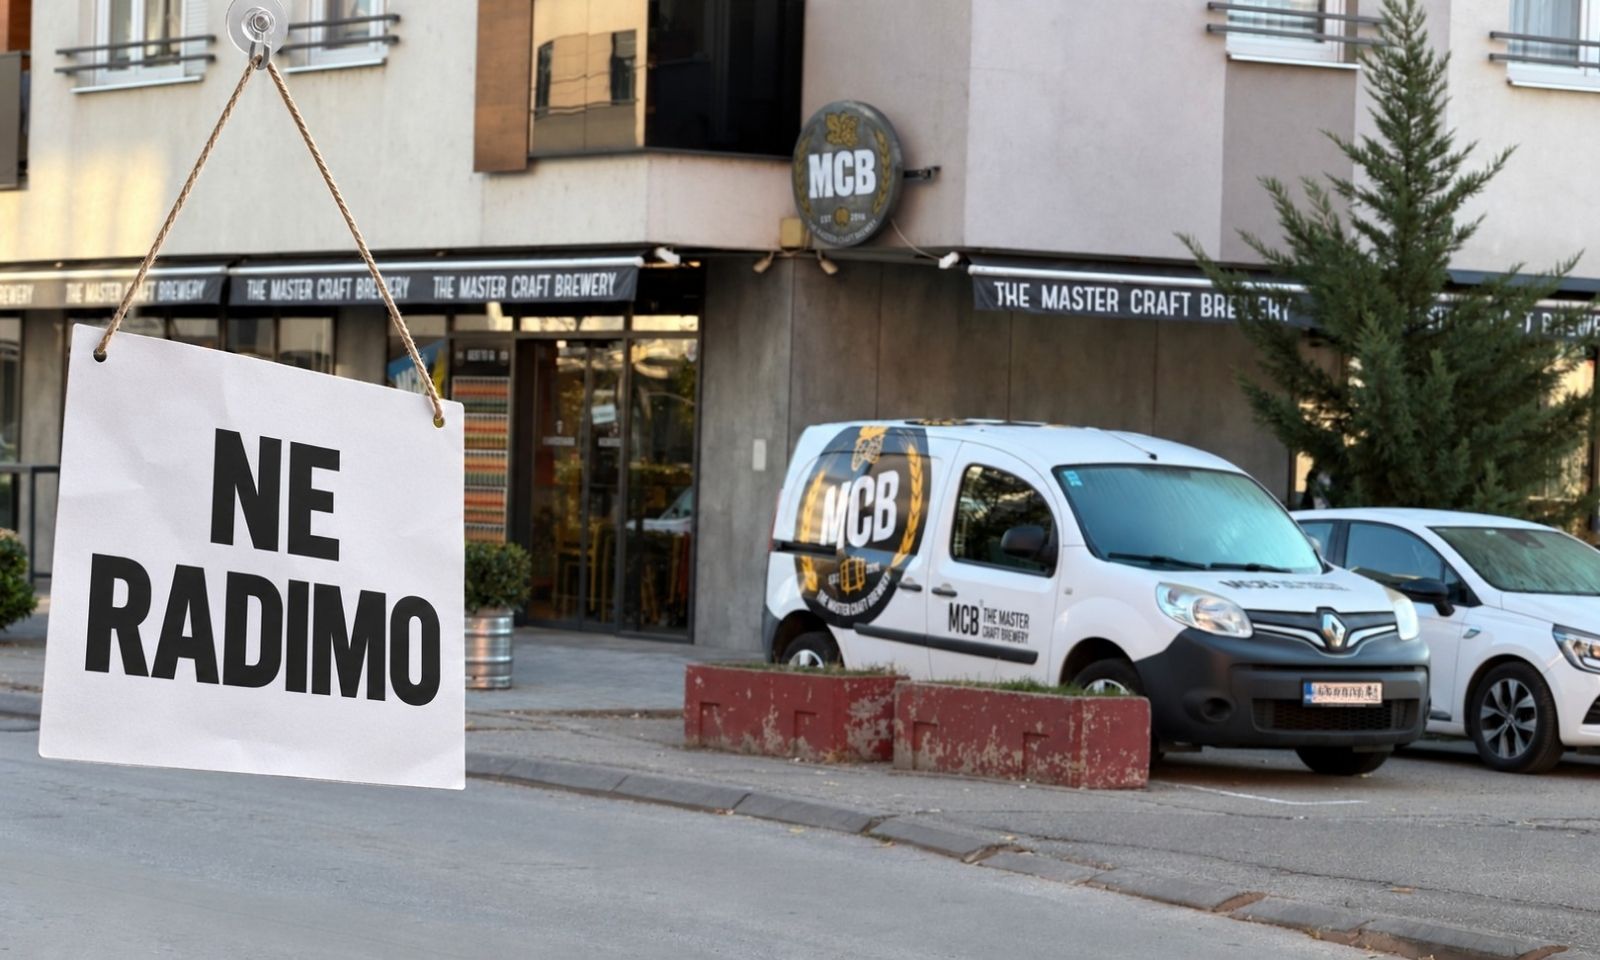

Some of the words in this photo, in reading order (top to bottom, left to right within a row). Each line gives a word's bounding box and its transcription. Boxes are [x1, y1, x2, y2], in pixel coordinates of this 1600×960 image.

[808, 149, 876, 199] MCB
[66, 282, 83, 304] THE
[85, 282, 122, 304] MASTER
[157, 279, 207, 302] BREWERY
[247, 279, 267, 301] THE
[270, 278, 314, 301] MASTER
[317, 277, 353, 300] CRAFT
[433, 276, 456, 299] THE
[459, 275, 507, 299] MASTER
[511, 274, 551, 299] CRAFT
[555, 272, 617, 298] BREWERY
[994, 281, 1030, 308] THE
[1041, 284, 1119, 313] MASTER
[1130, 288, 1191, 317] CRAFT
[210, 428, 341, 562] NE
[820, 470, 900, 553] MCB
[85, 552, 441, 707] RADIMO
[948, 602, 979, 636] MCB
[982, 625, 1000, 640] CRAFT
[1001, 628, 1029, 644] BREWERY
[983, 607, 997, 625] THE
[999, 610, 1030, 630] MASTER
